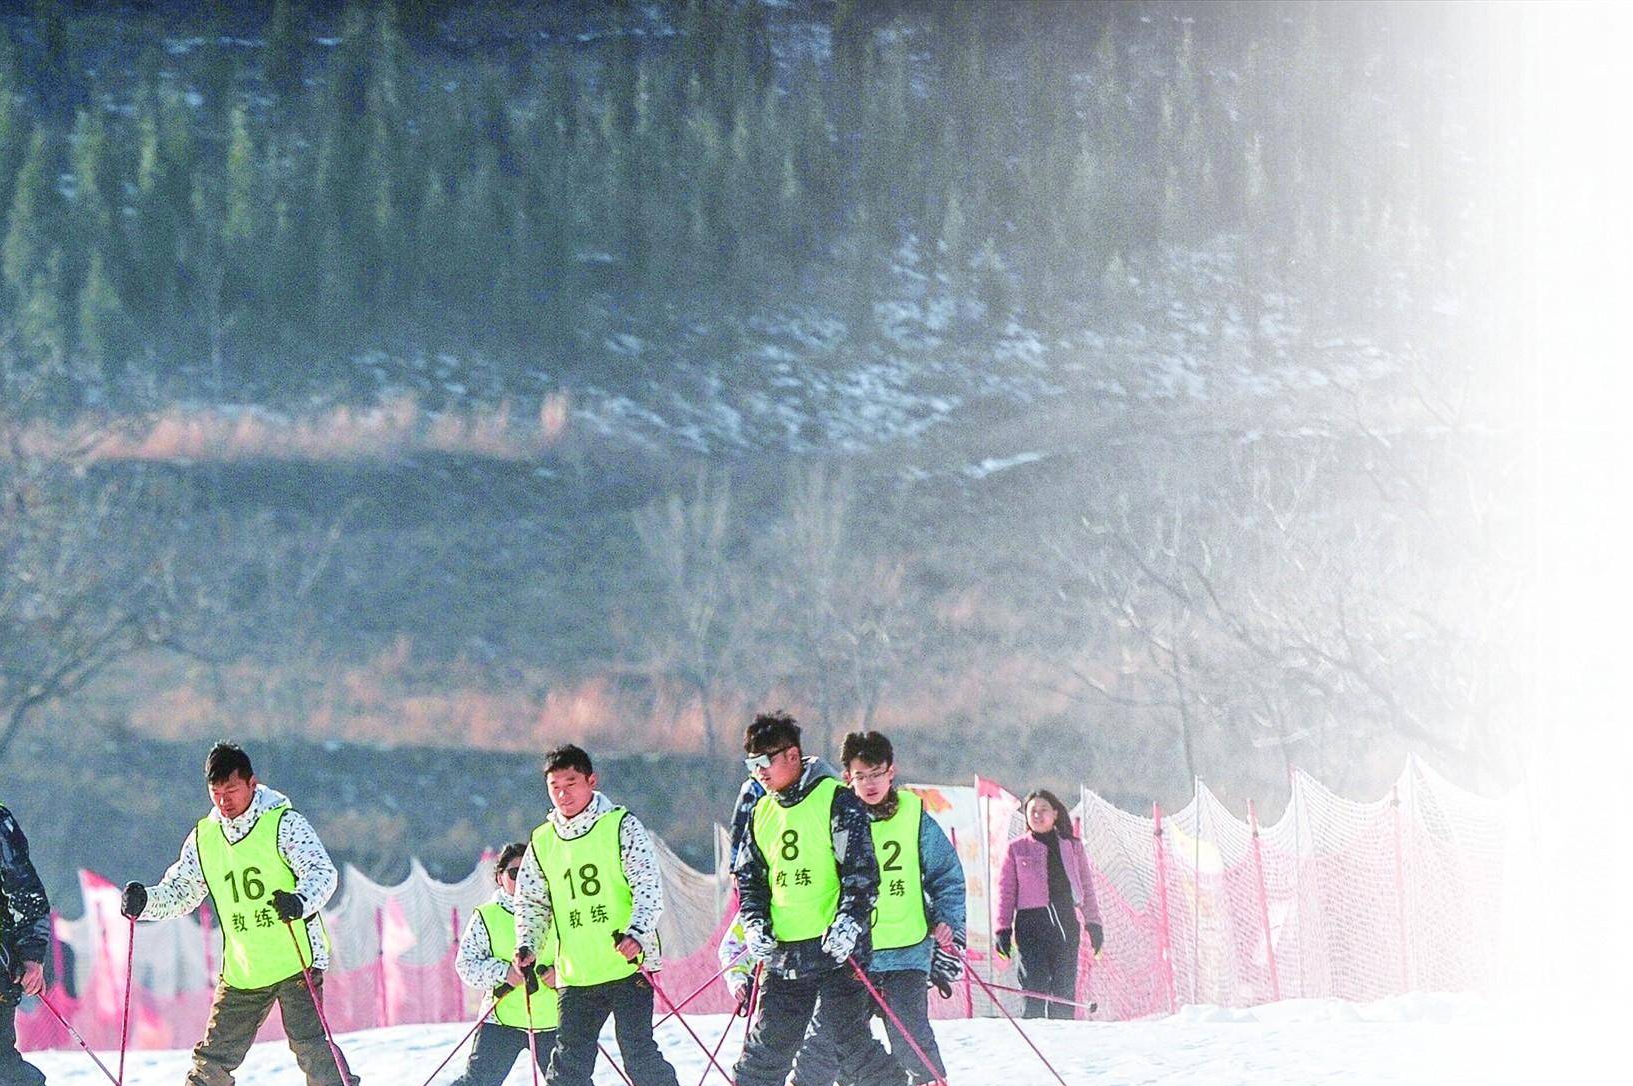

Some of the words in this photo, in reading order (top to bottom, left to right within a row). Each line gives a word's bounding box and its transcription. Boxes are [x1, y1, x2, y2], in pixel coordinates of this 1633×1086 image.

[781, 829, 799, 861] 8
[224, 866, 265, 902] 16
[563, 864, 601, 899] 18
[775, 868, 812, 888] 教练
[889, 879, 905, 897] 练
[232, 908, 274, 931] 教练
[569, 904, 609, 929] 教练
